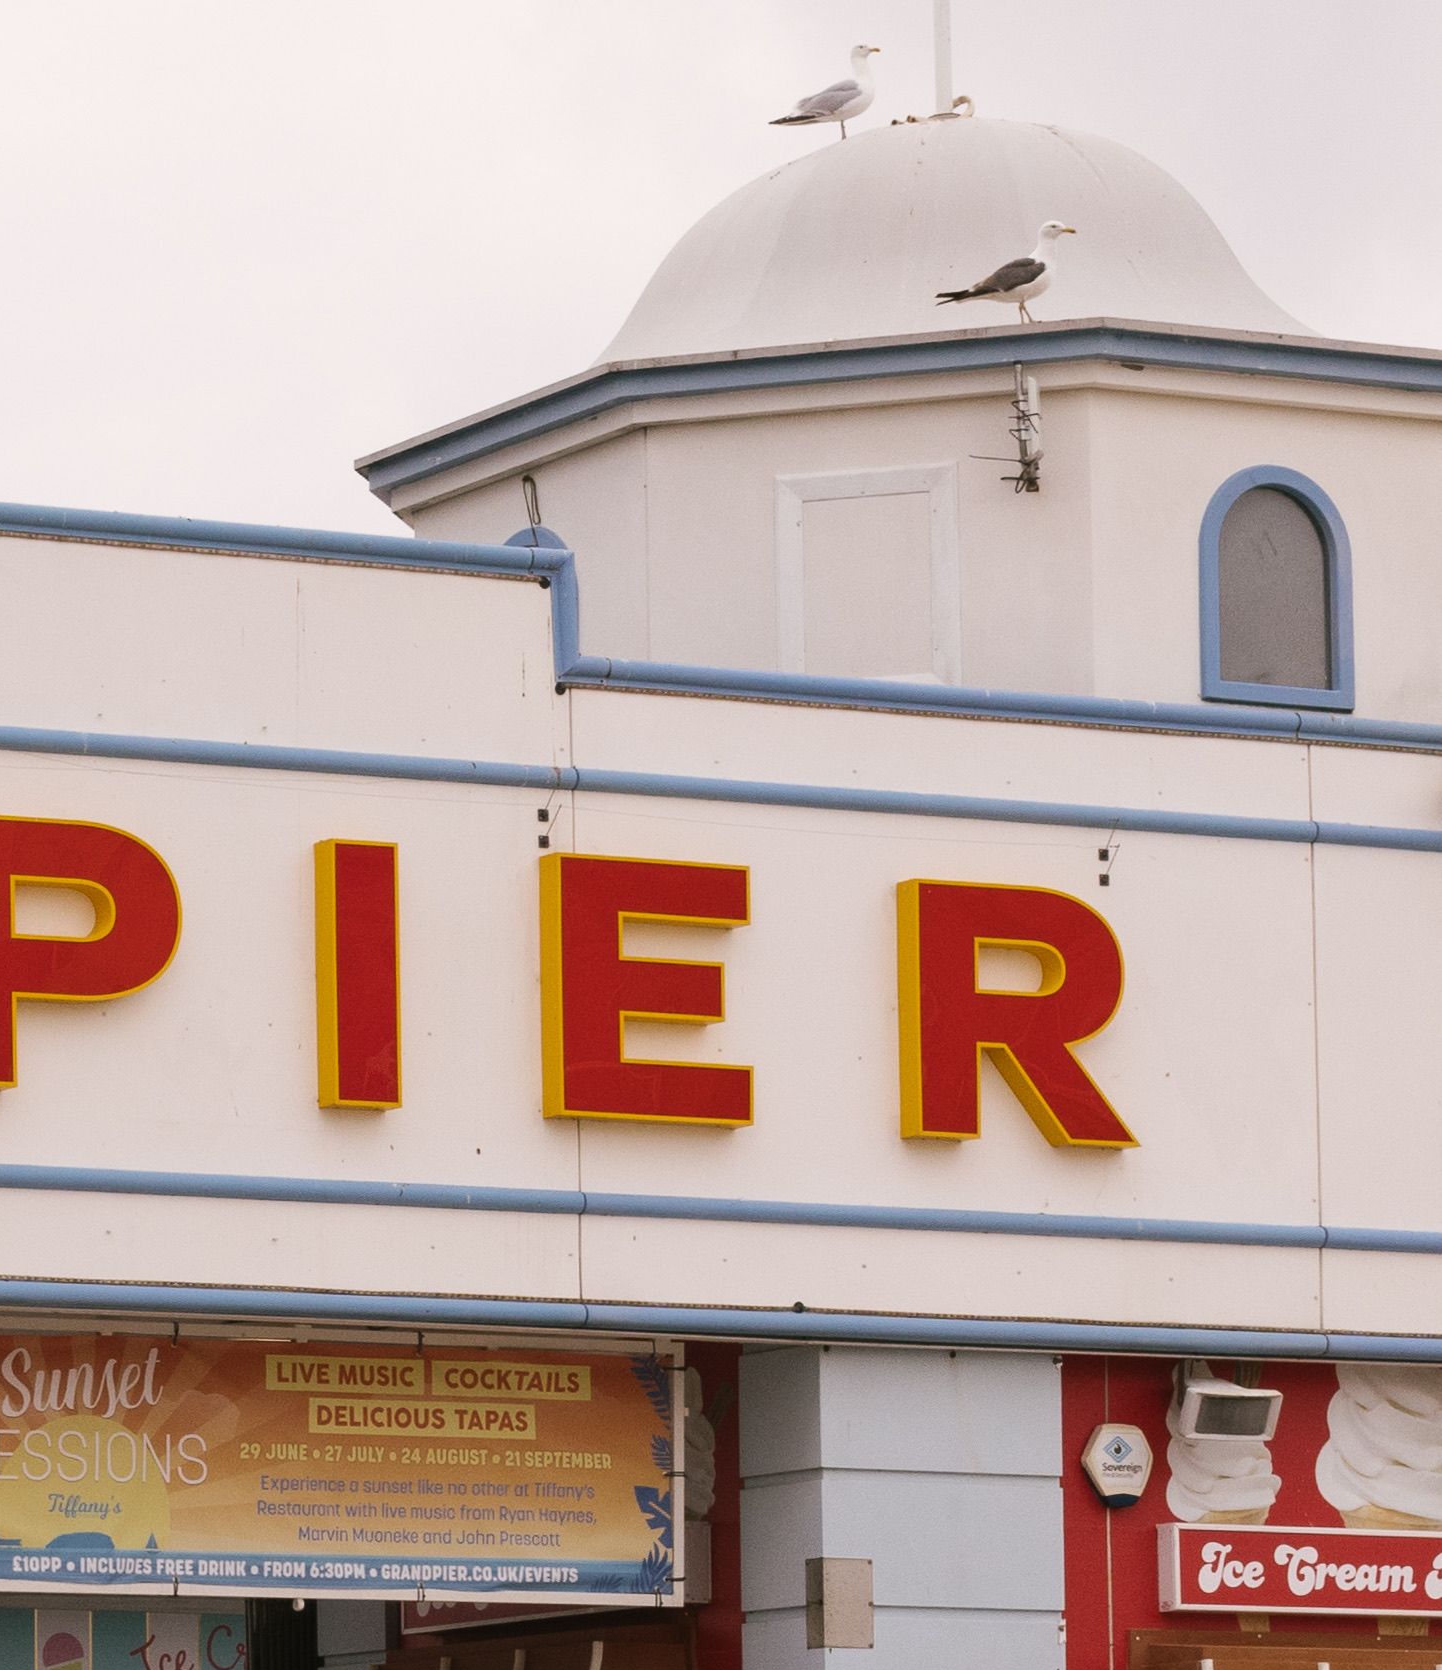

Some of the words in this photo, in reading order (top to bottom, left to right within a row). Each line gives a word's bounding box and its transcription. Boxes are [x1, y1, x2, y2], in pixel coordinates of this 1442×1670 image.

[0, 1348, 164, 1419] Sunset
[276, 1362, 329, 1384] LIVE
[338, 1365, 414, 1388] MUSIC
[444, 1367, 580, 1393] COCKTAILS
[316, 1404, 445, 1429] DELICIOUS
[455, 1409, 528, 1432] TAPAS
[240, 1443, 260, 1459] 29
[266, 1444, 307, 1460] JUNE
[325, 1448, 342, 1462] 27
[347, 1448, 384, 1463] JULY
[401, 1449, 421, 1464] 24
[426, 1449, 487, 1466] AUGUST
[505, 1451, 521, 1468] 21
[524, 1451, 612, 1469] SEPTEMBER
[1102, 1462, 1142, 1473] Sovereign
[260, 1475, 345, 1494] Experience
[349, 1480, 358, 1492] a
[364, 1478, 414, 1494] sunset
[418, 1480, 444, 1496] like
[448, 1483, 466, 1496] no
[472, 1481, 509, 1497] other
[516, 1485, 529, 1497] at
[535, 1482, 595, 1500] Tiffany's
[48, 1494, 122, 1520] Tiffany's
[12, 1556, 62, 1573] £10PP
[80, 1557, 151, 1575] INCLUDES
[156, 1559, 194, 1575] FREE
[198, 1560, 246, 1577] DRINK
[263, 1563, 305, 1577] FROM
[310, 1563, 366, 1580] 6:30PM
[381, 1566, 578, 1584] GRANDPIER.CO.UK/EVENTS
[1198, 1541, 1265, 1594] Ice
[1274, 1544, 1417, 1596] Cream
